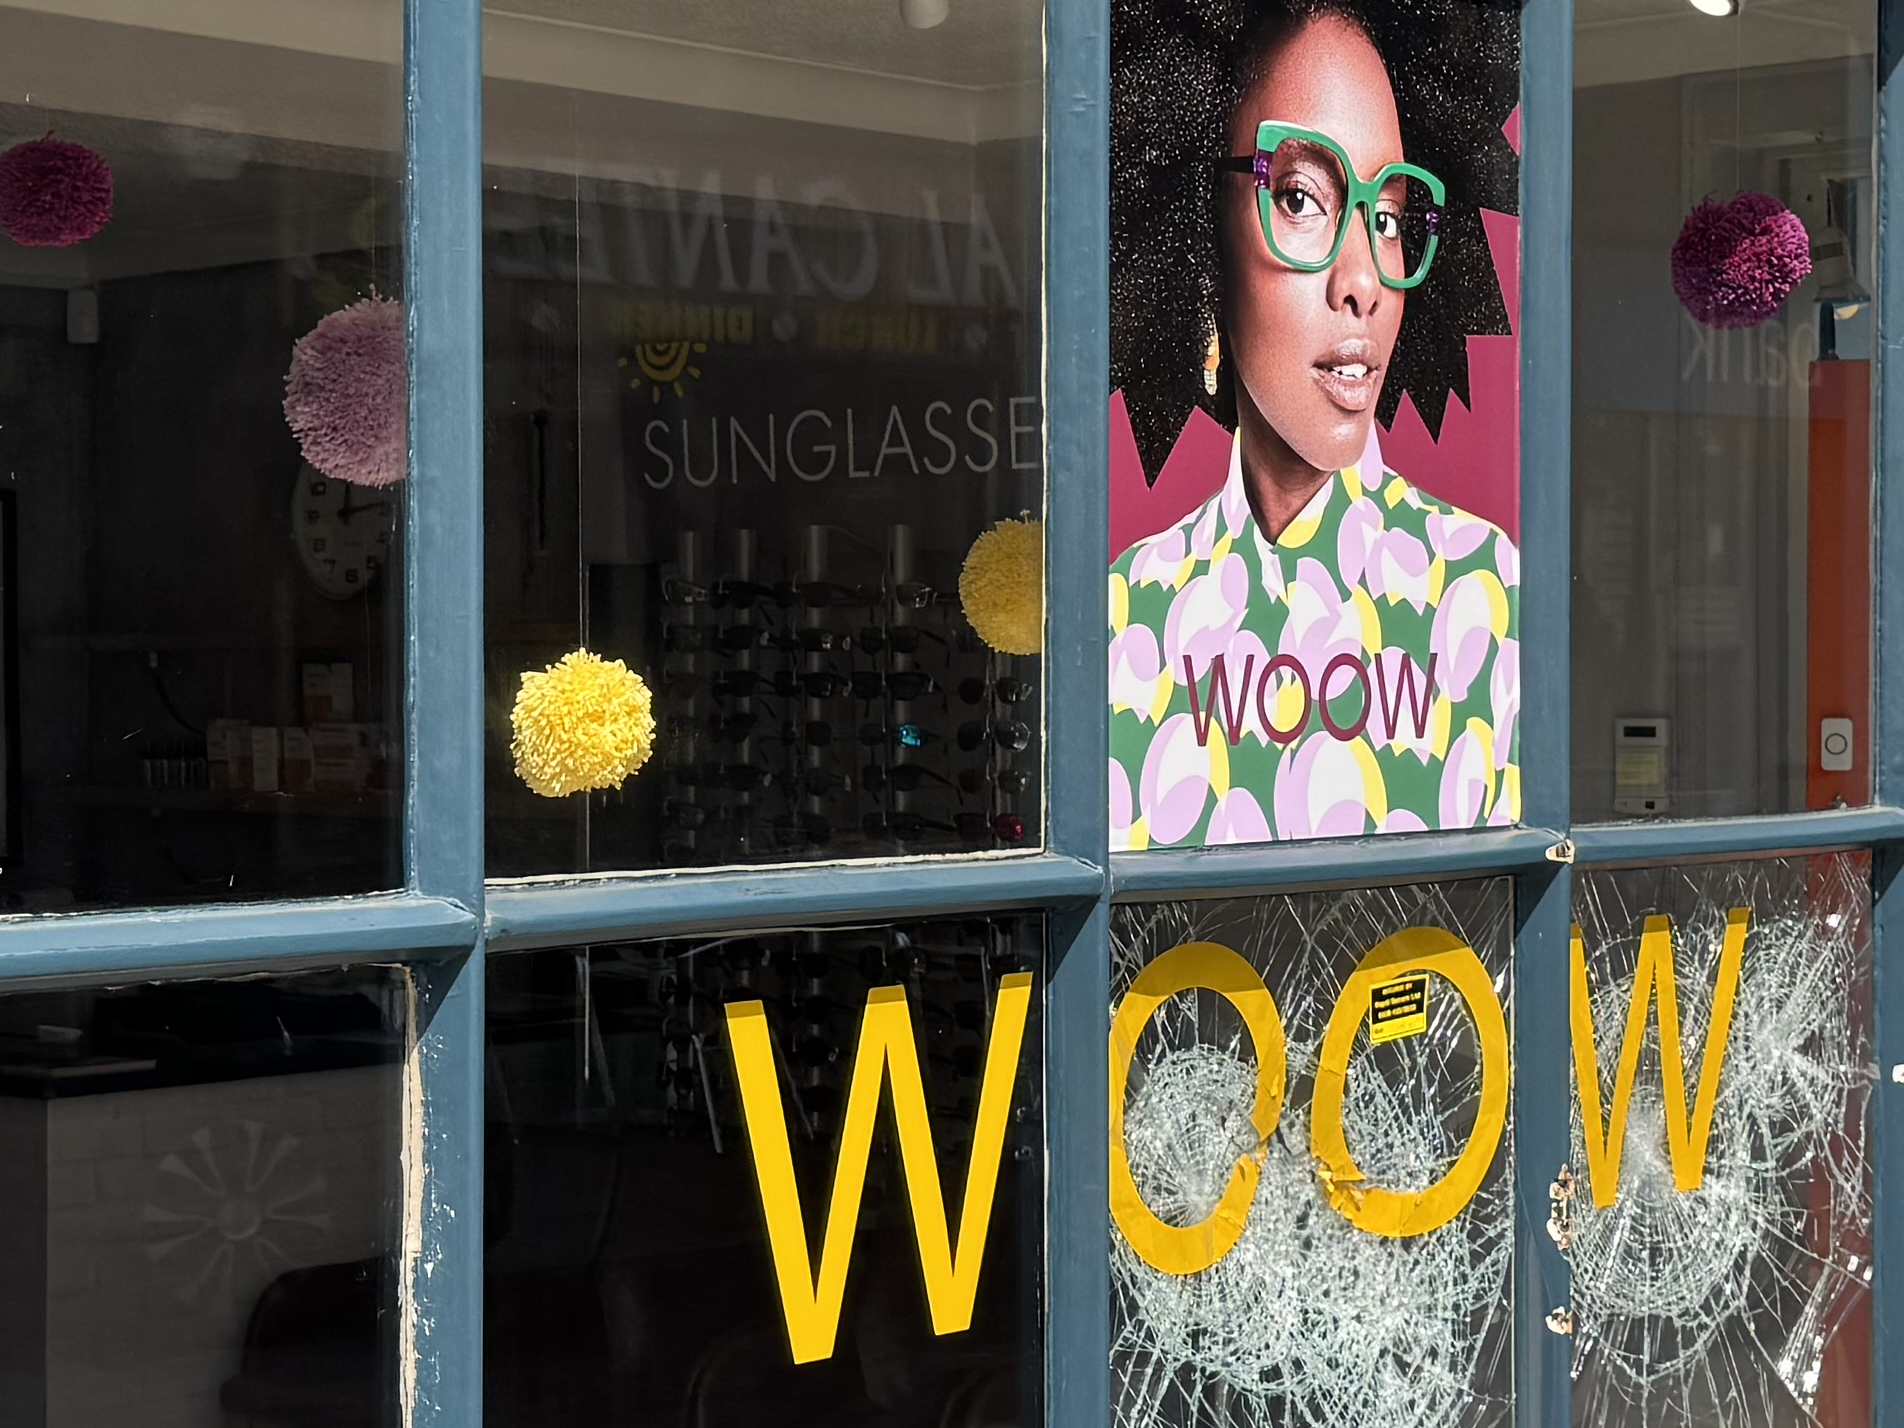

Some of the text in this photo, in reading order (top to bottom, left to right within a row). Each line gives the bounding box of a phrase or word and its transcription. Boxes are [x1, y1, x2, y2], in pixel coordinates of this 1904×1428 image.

[643, 396, 1042, 490] SUNGLASSE
[1182, 652, 1438, 747] WOOW
[724, 906, 1751, 1365] WOOW
